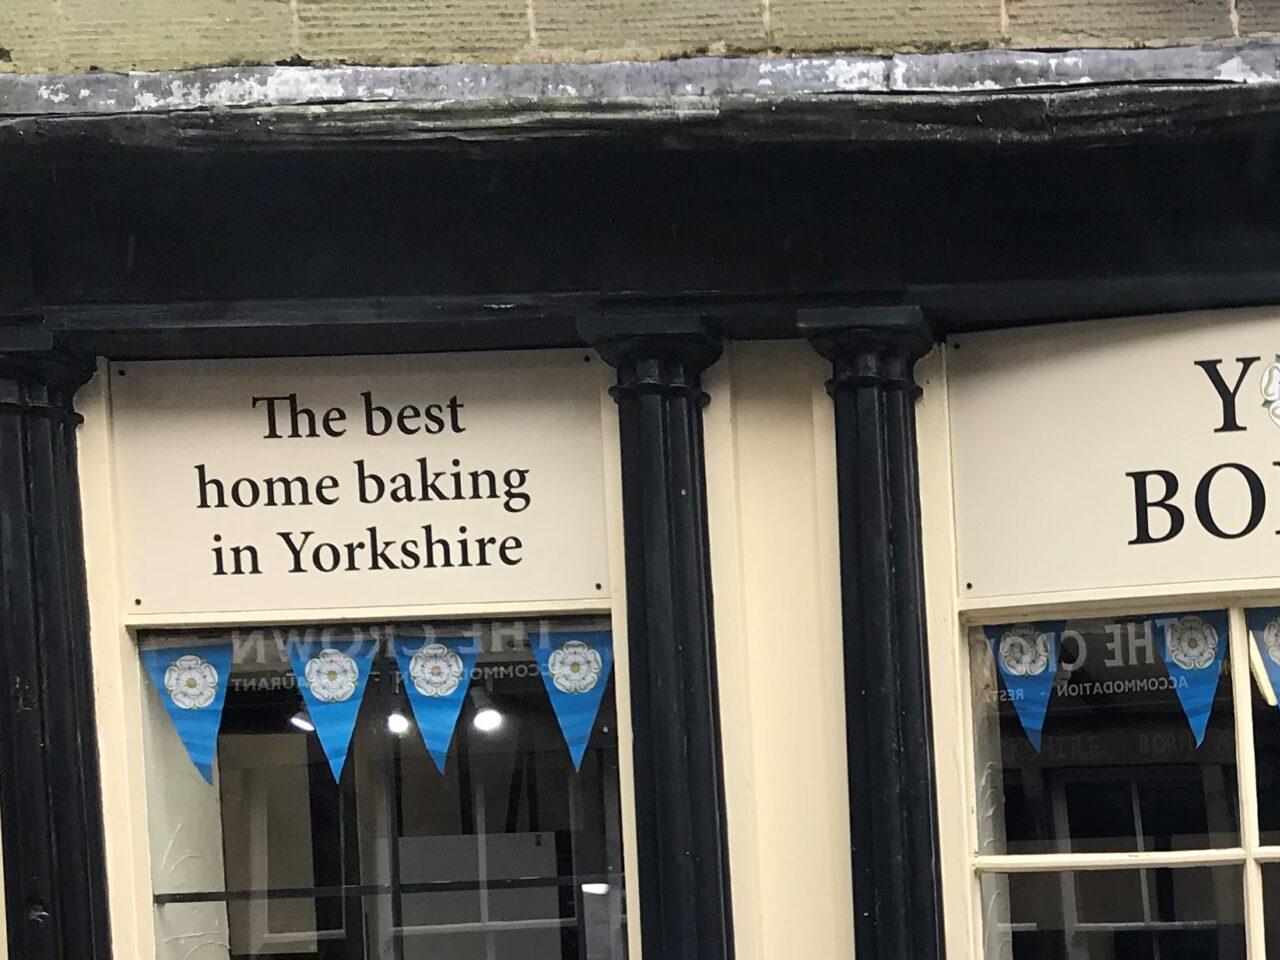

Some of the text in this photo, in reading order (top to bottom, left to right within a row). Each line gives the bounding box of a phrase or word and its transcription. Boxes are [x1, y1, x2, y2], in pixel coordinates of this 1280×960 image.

[251, 391, 466, 439] The best
[194, 457, 532, 514] home baking
[212, 524, 523, 576] in Yorkshire
